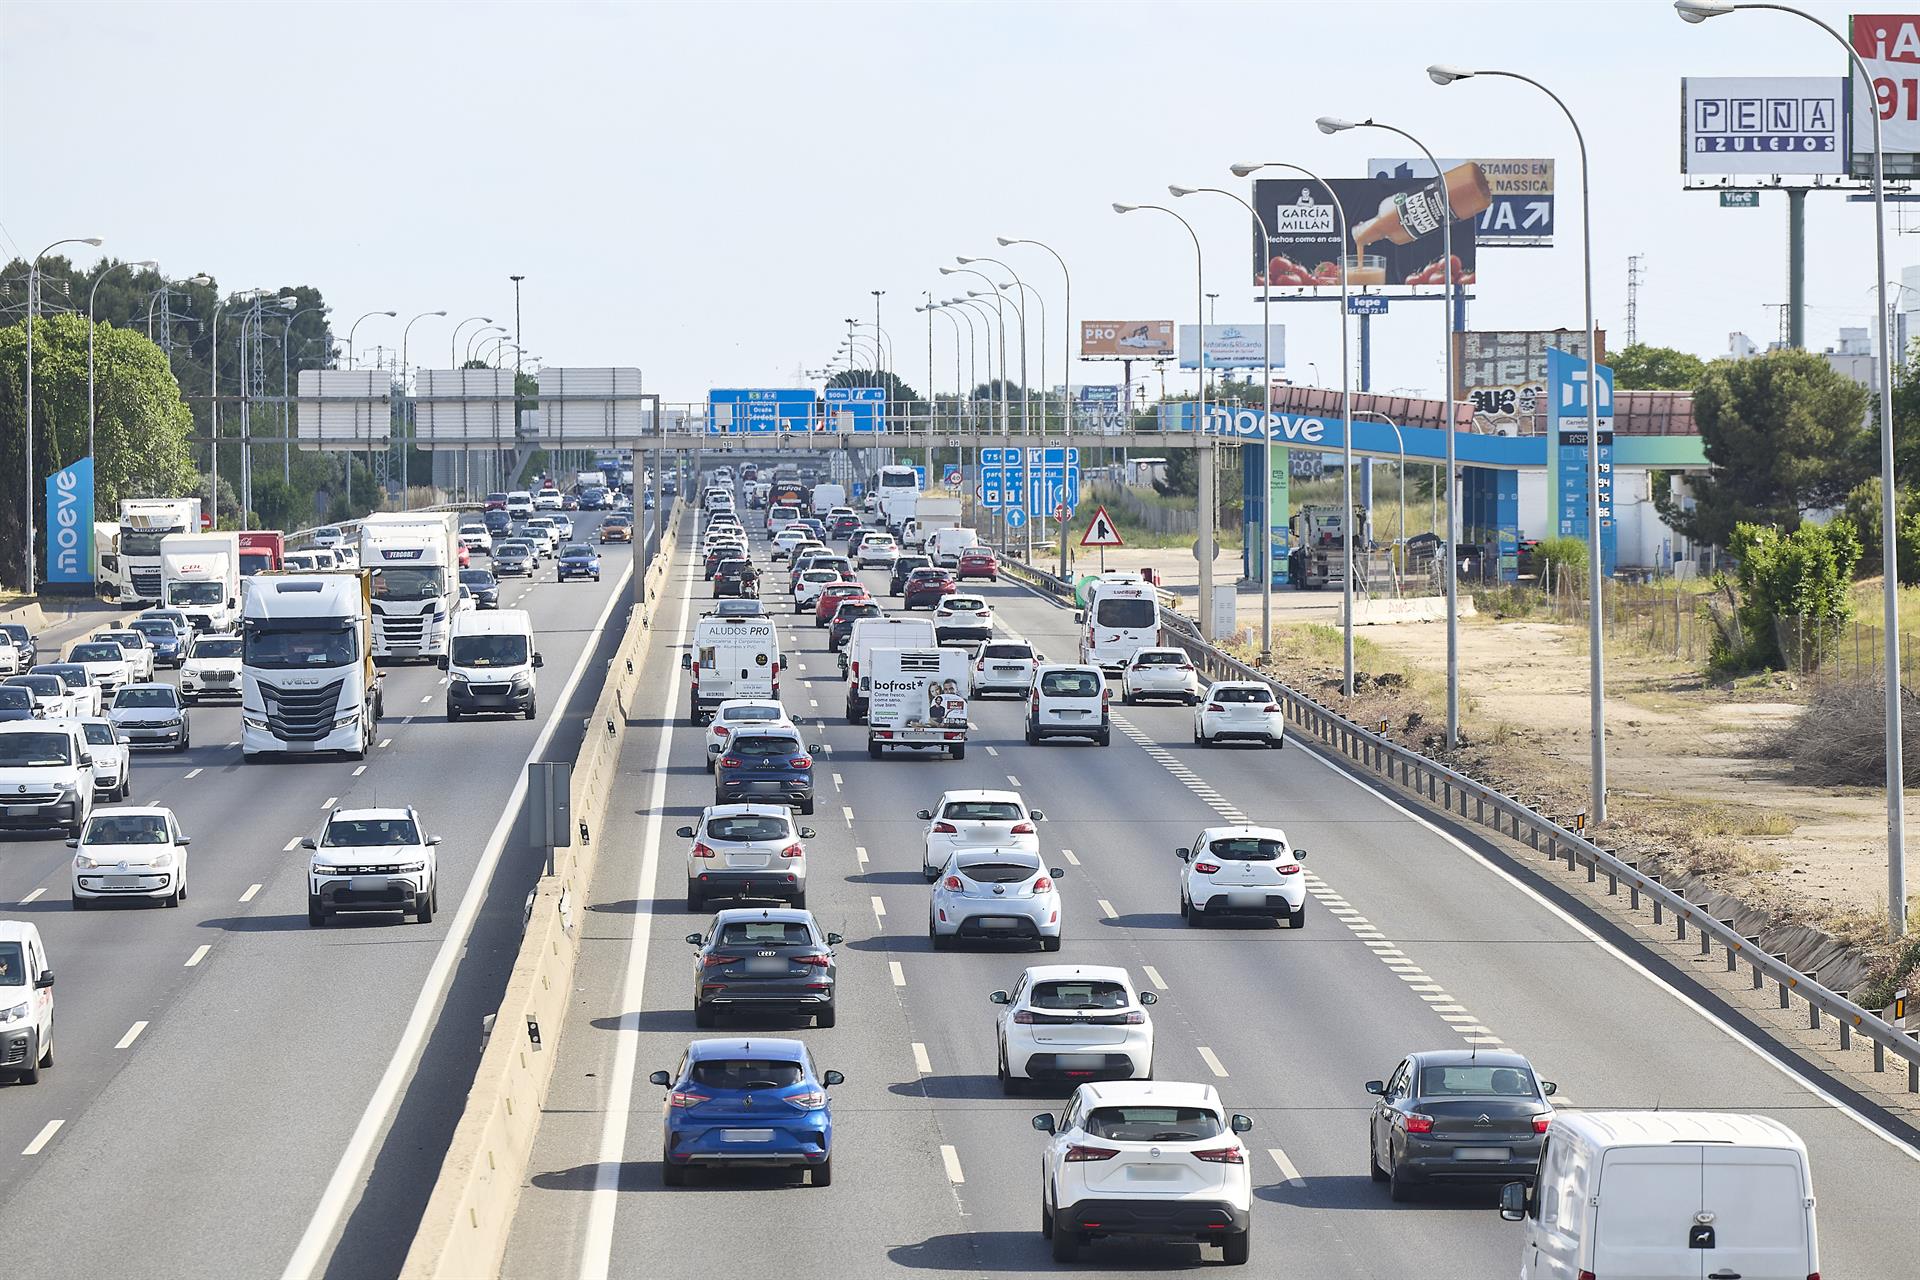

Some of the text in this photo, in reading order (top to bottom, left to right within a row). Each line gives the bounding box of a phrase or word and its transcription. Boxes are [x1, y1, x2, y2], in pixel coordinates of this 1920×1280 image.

[1870, 77, 1919, 121] 91
[1702, 101, 1827, 129] PEÑA
[1697, 137, 1835, 151] AZULEJOS
[1480, 163, 1548, 175] STAMOS EN
[1496, 180, 1549, 192] NASSICA
[1282, 207, 1329, 219] GARCÍA
[1282, 219, 1330, 230] MILLÁN
[1085, 328, 1116, 340] PRO
[1203, 408, 1325, 442] moeve
[1055, 509, 1071, 518] STP
[56, 470, 78, 574] moeve
[709, 627, 770, 636] ALUDOS PRO
